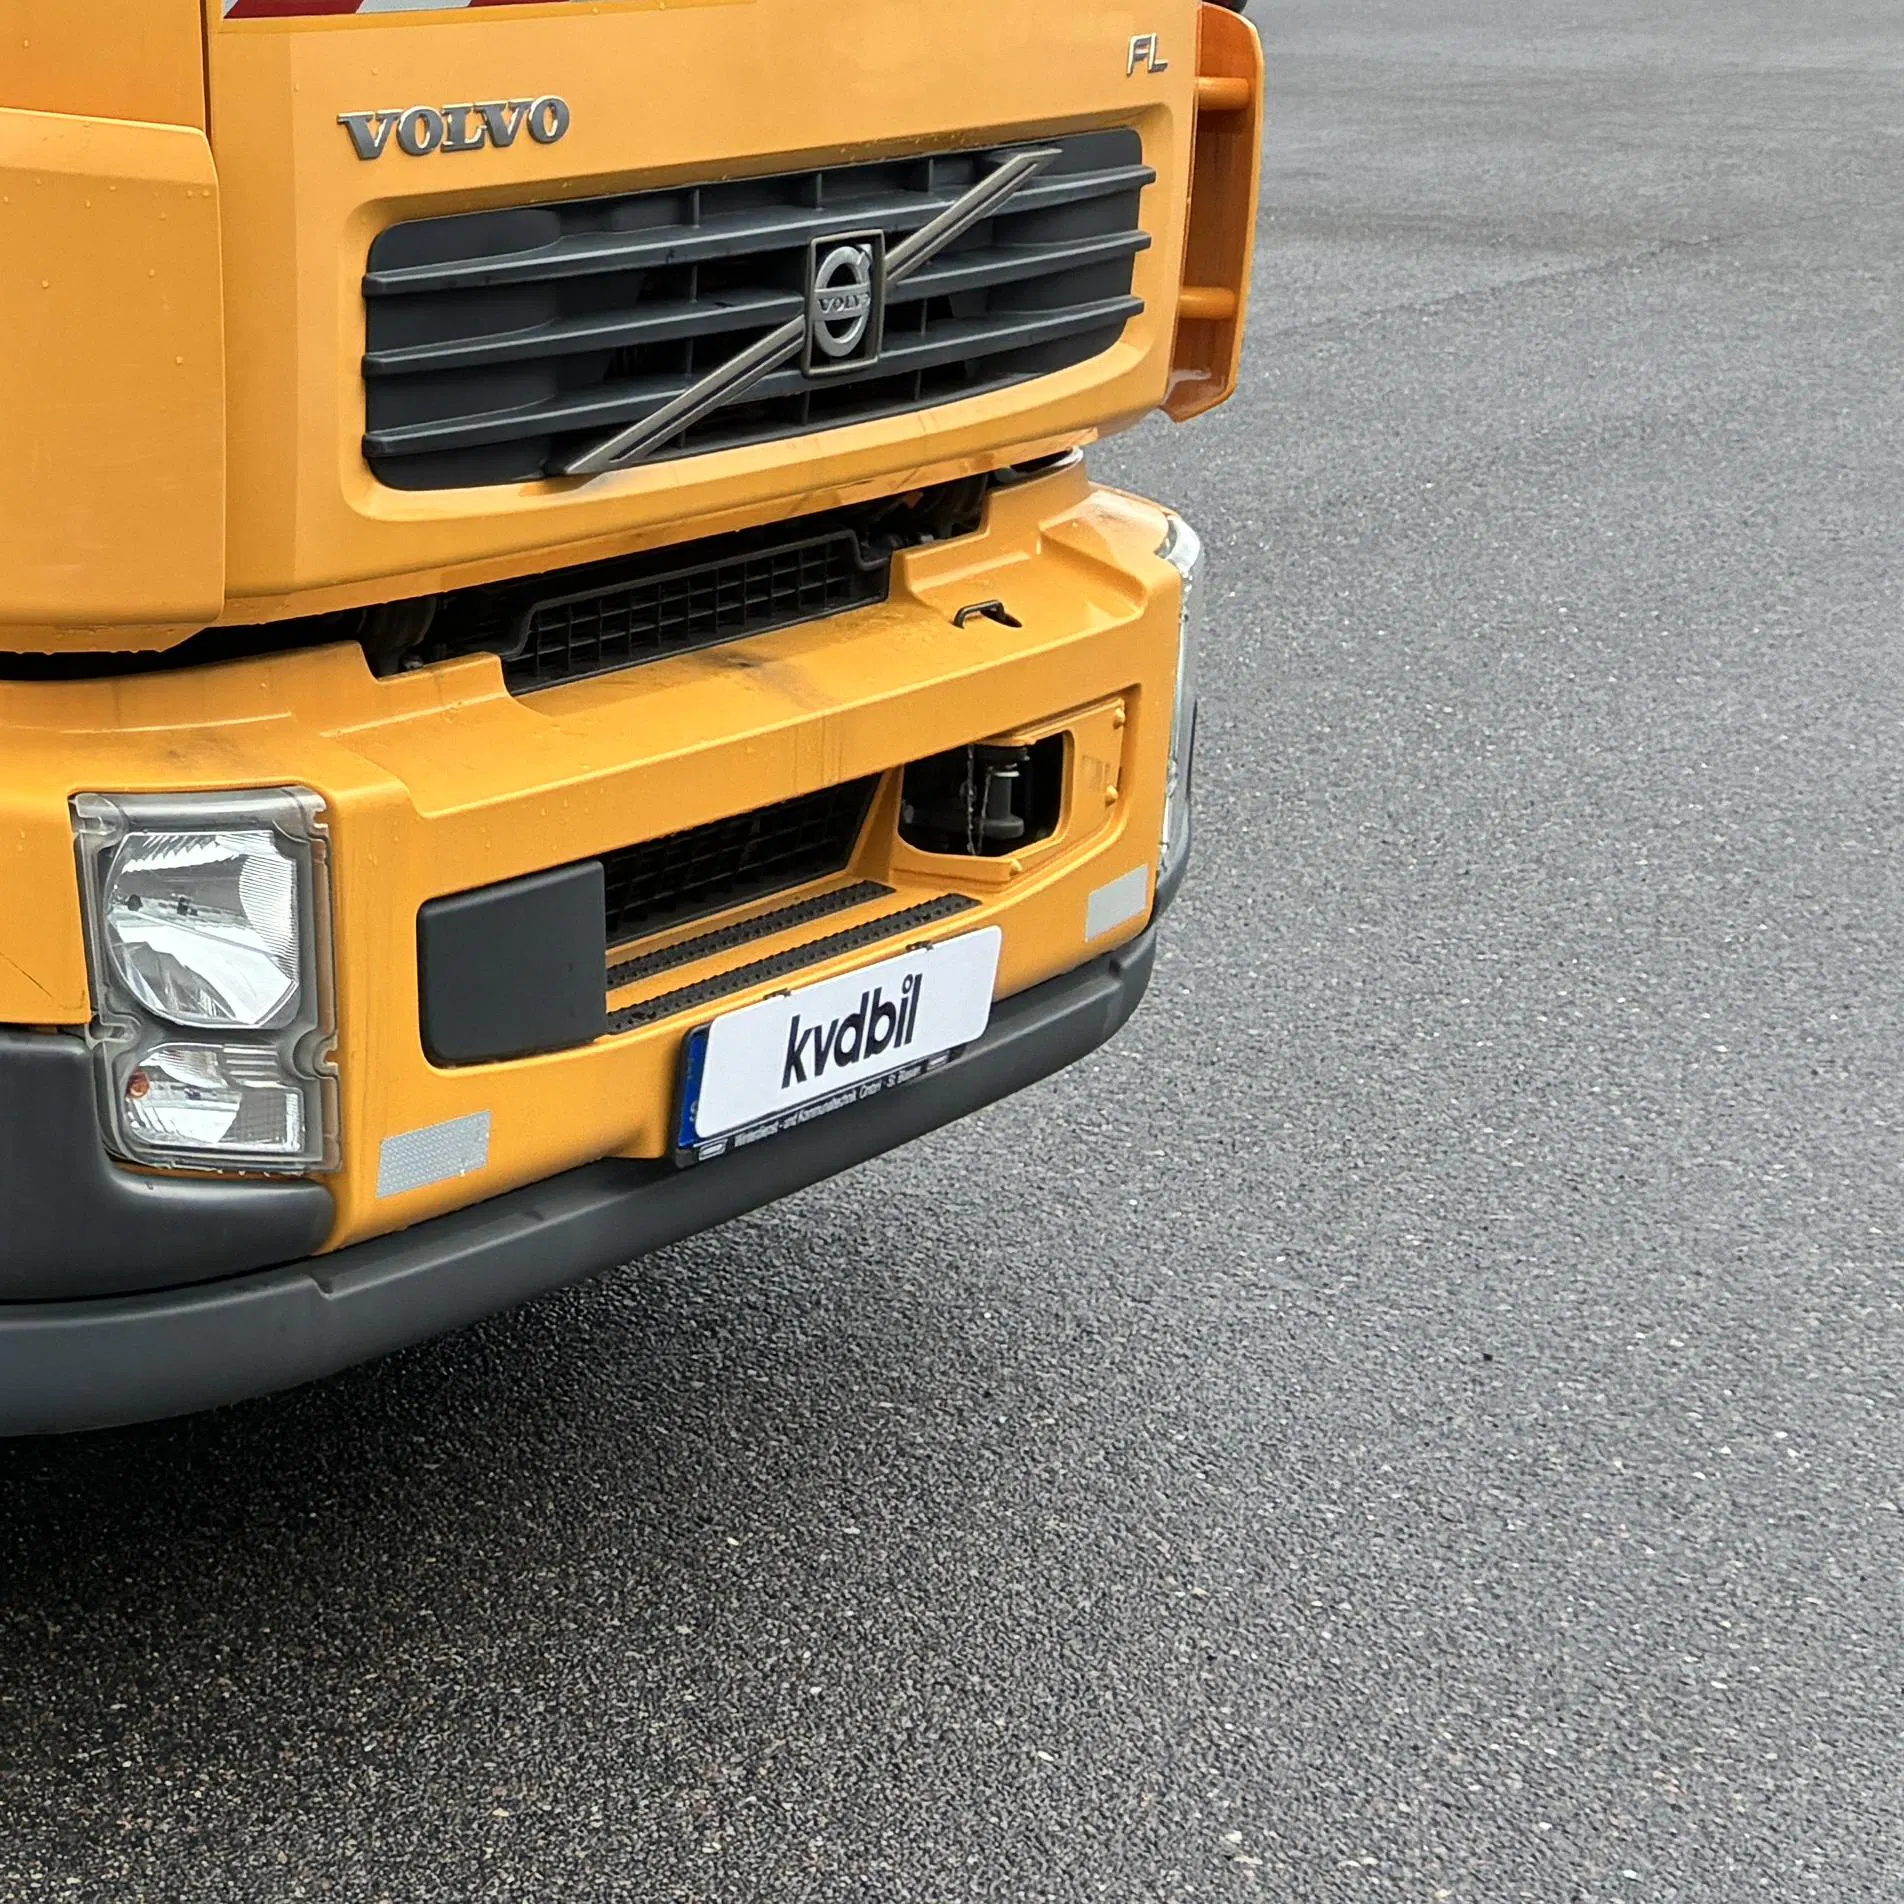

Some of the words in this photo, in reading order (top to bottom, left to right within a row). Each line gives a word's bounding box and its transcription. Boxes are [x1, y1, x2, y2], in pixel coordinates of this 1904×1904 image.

[1125, 32, 1169, 79] FL
[336, 94, 571, 161] VOLVO
[781, 972, 924, 1090] kvdbil
